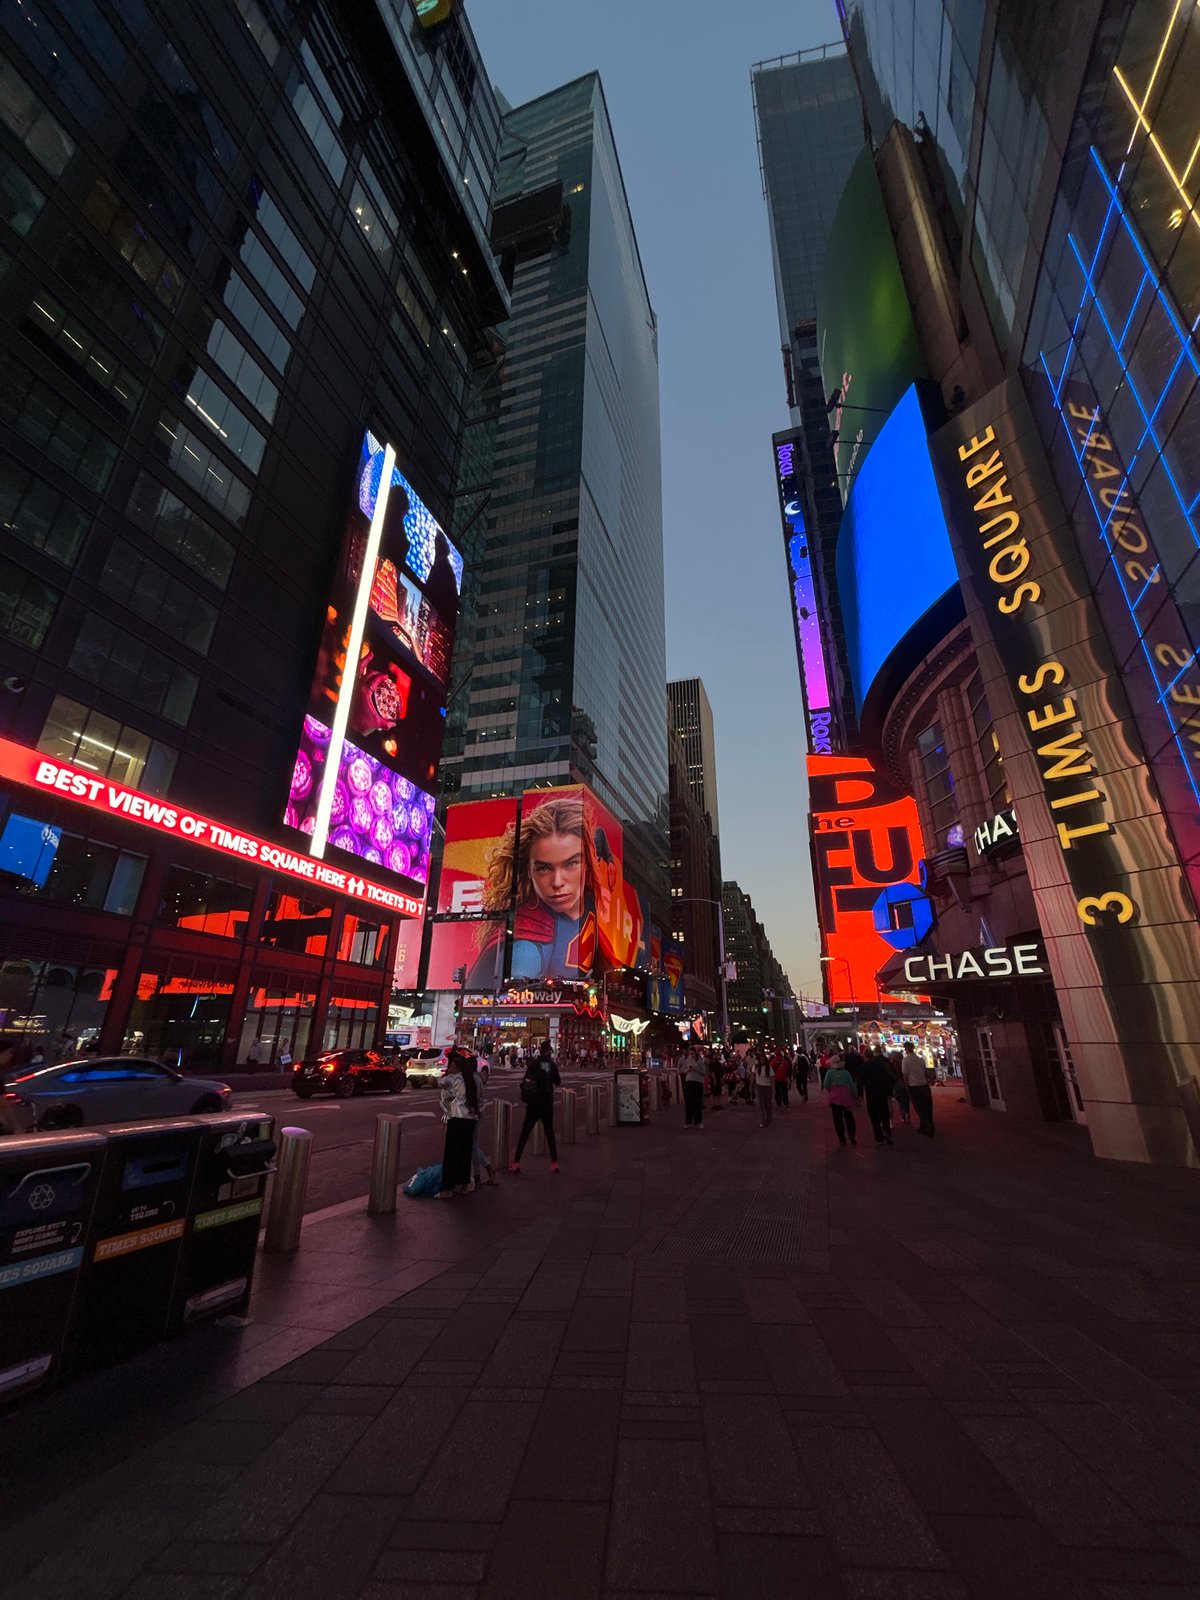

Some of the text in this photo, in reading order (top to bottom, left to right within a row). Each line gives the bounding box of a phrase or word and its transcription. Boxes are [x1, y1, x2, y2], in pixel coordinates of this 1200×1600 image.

[958, 424, 1135, 927] 3 TIMES SQUARE
[810, 712, 832, 754] ROK
[35, 761, 104, 800] BEST
[109, 787, 177, 828] VIEWS
[180, 817, 208, 837] OF
[209, 825, 259, 857] TIMES
[260, 845, 316, 878] SQUARE
[316, 866, 346, 889] HERE
[367, 885, 405, 909] TICKETS
[405, 901, 418, 913] TO
[974, 809, 1019, 855] CHA
[905, 943, 1044, 983] CHASE
[507, 988, 562, 1004] Subway
[98, 1223, 183, 1256] TIMES SQUARE
[23, 1253, 75, 1277] SQUARE
